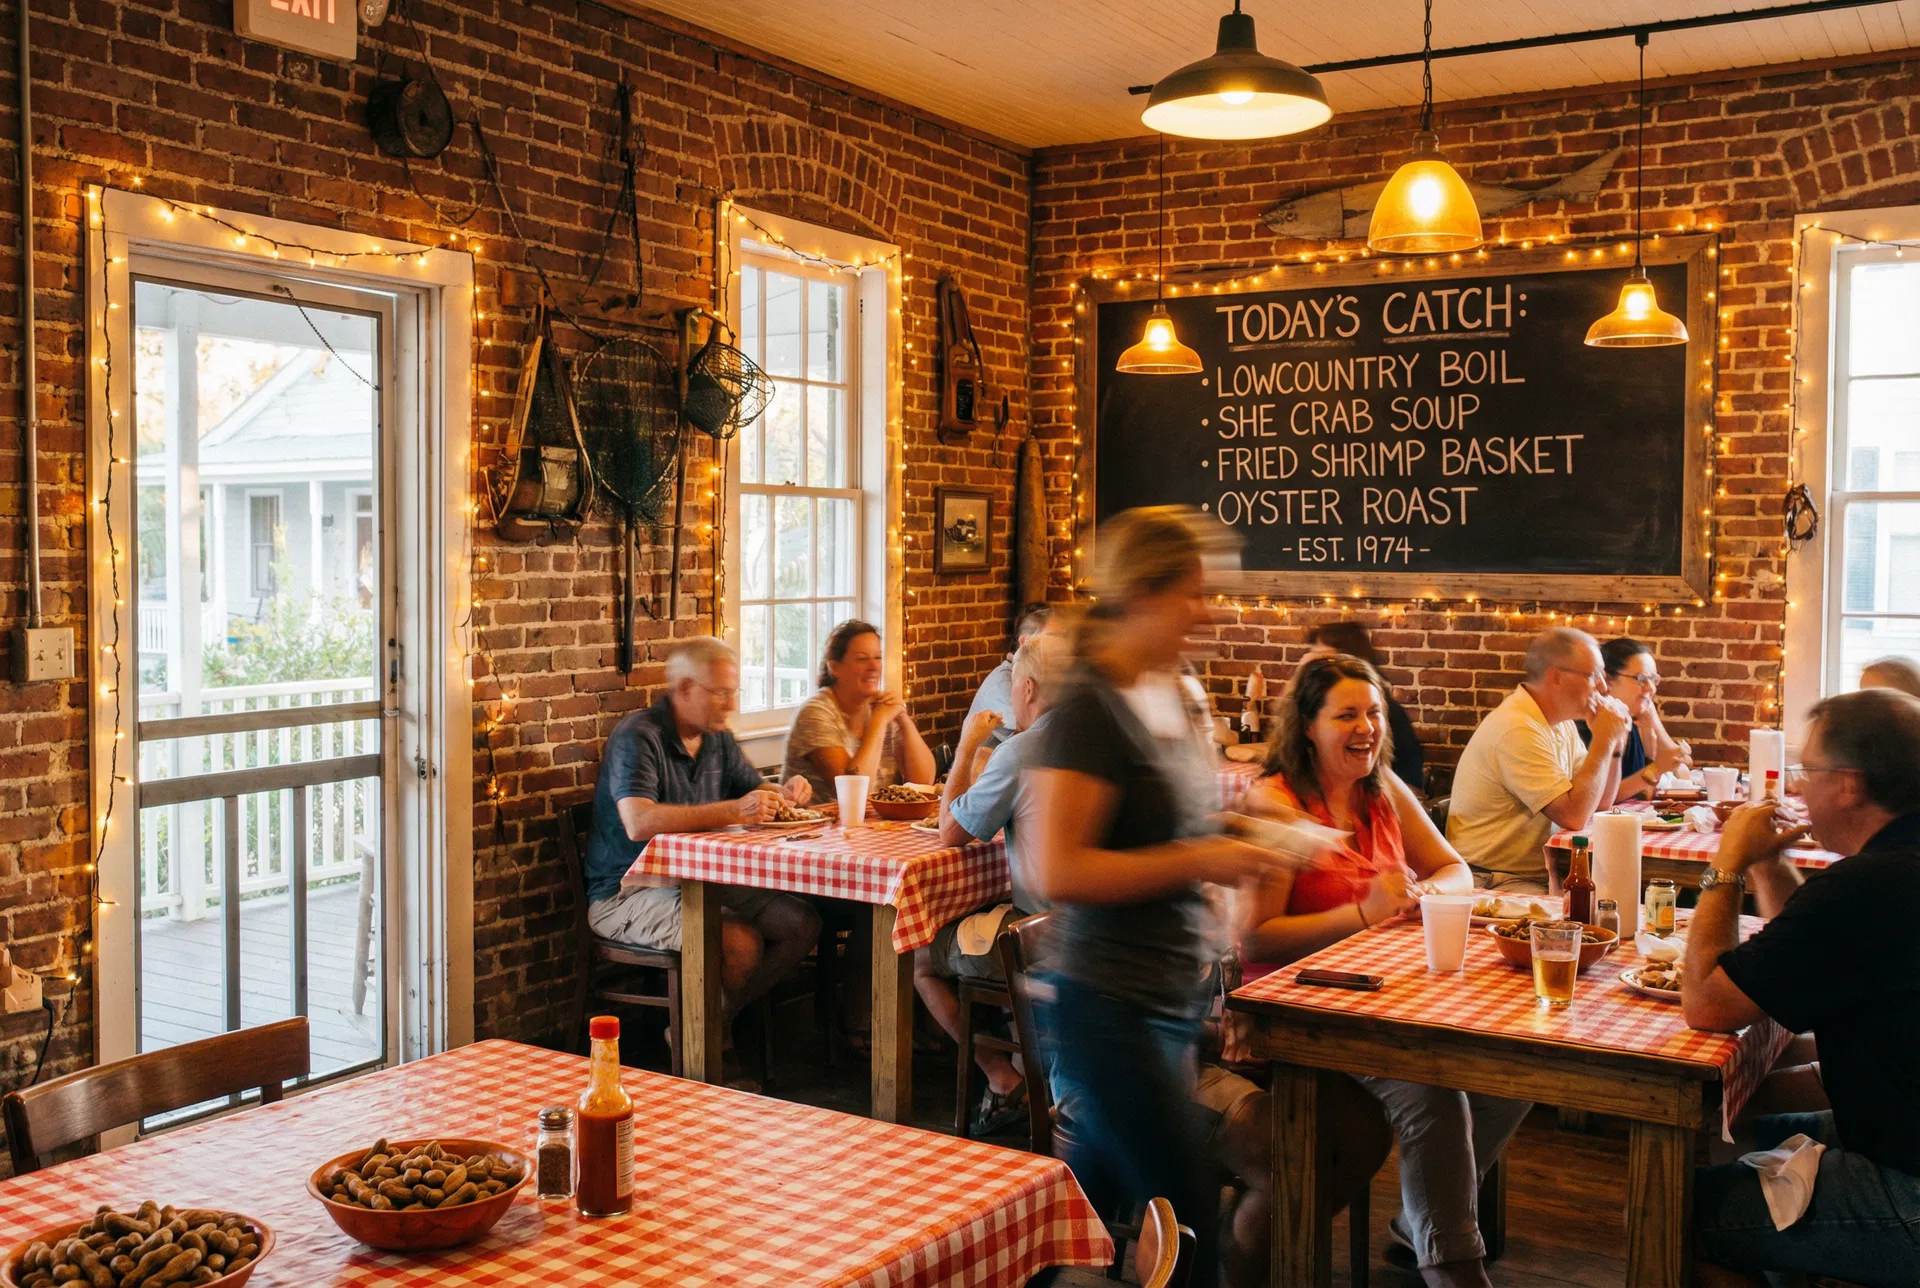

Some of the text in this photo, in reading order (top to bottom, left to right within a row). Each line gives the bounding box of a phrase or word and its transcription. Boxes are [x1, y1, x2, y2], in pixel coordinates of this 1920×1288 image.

[1216, 284, 1527, 343] TODAY'S CATCH:
[1217, 350, 1525, 398] LOWCOUNTRY BOIL
[1218, 394, 1480, 439] SHE CRAB SOUP
[1218, 434, 1585, 481] FRIED SHRIMP BASKET
[1218, 487, 1479, 525] OYSTER ROAST
